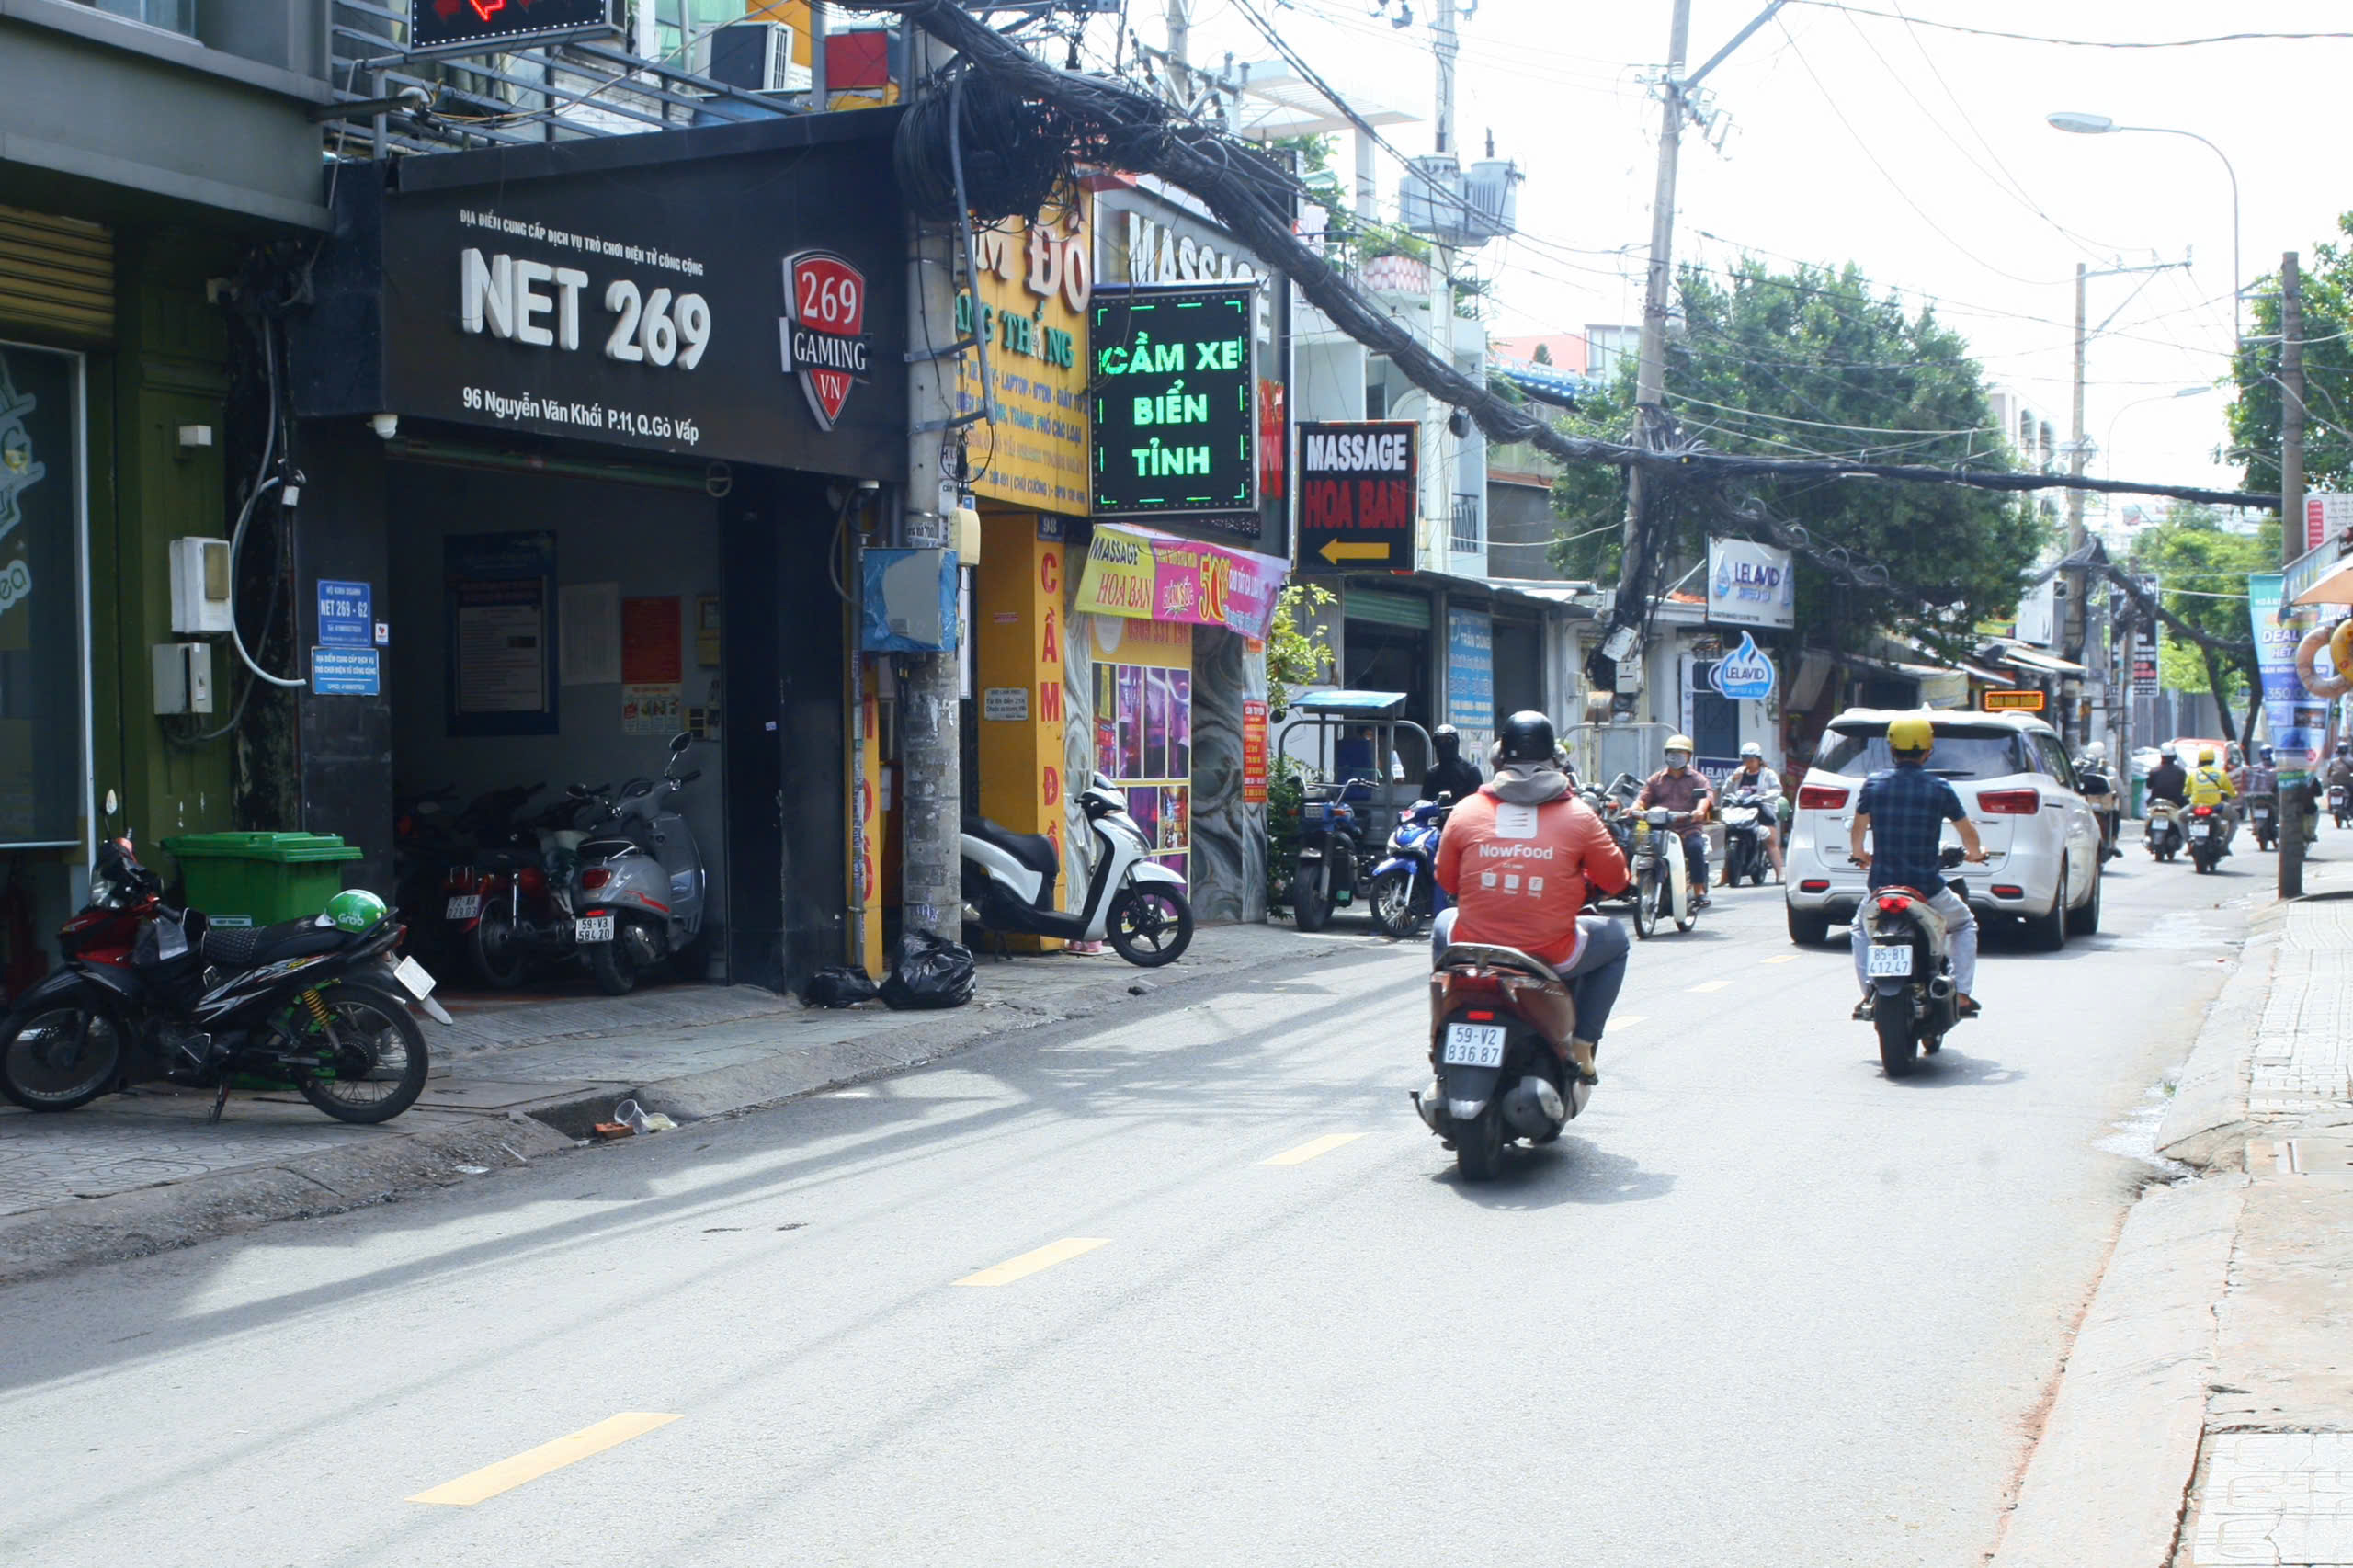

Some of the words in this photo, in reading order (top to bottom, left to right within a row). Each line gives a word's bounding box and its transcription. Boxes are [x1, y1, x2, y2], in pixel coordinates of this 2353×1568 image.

[502, 218, 527, 236] CUNG
[528, 221, 546, 241] CẤP
[570, 233, 584, 253] VỤ
[584, 235, 602, 253] TRÒ
[603, 240, 624, 258] CHƠI
[658, 252, 681, 271] CÔNG
[681, 257, 704, 277] CỘNG
[461, 247, 588, 351] NET
[605, 279, 711, 370] 269
[801, 271, 857, 324] 269
[793, 332, 867, 371] GAMING
[1102, 331, 1185, 375] CẦM
[1195, 341, 1239, 371] XE
[819, 373, 841, 400] VN
[462, 386, 482, 410] 96
[484, 391, 540, 421] Nguyễn
[541, 398, 568, 423] Văn
[571, 403, 602, 427] Khối
[674, 418, 699, 446] Vấp
[1134, 378, 1209, 426] BIỂN
[1131, 437, 1211, 477] TỈNH
[1306, 433, 1407, 472] MASSAGE
[1304, 479, 1354, 529] HOA
[1359, 479, 1408, 529] BAN
[1042, 517, 1057, 534] 98
[1089, 536, 1139, 566] MASSAGE
[1734, 562, 1780, 588] LELAVID
[1097, 572, 1127, 607] HOA
[1128, 575, 1153, 610] BAN
[320, 599, 335, 617] NET
[336, 600, 351, 618] 269
[358, 602, 368, 618] G2
[2262, 629, 2299, 643] DEAL
[1725, 667, 1765, 681] LELAVID
[1478, 843, 1554, 860] NowFood
[337, 912, 365, 926] Grab
[581, 917, 608, 929] 59-V3
[577, 928, 610, 942] 584.20
[1455, 1027, 1497, 1045] 59-V2
[1448, 1044, 1499, 1063] 836.87
